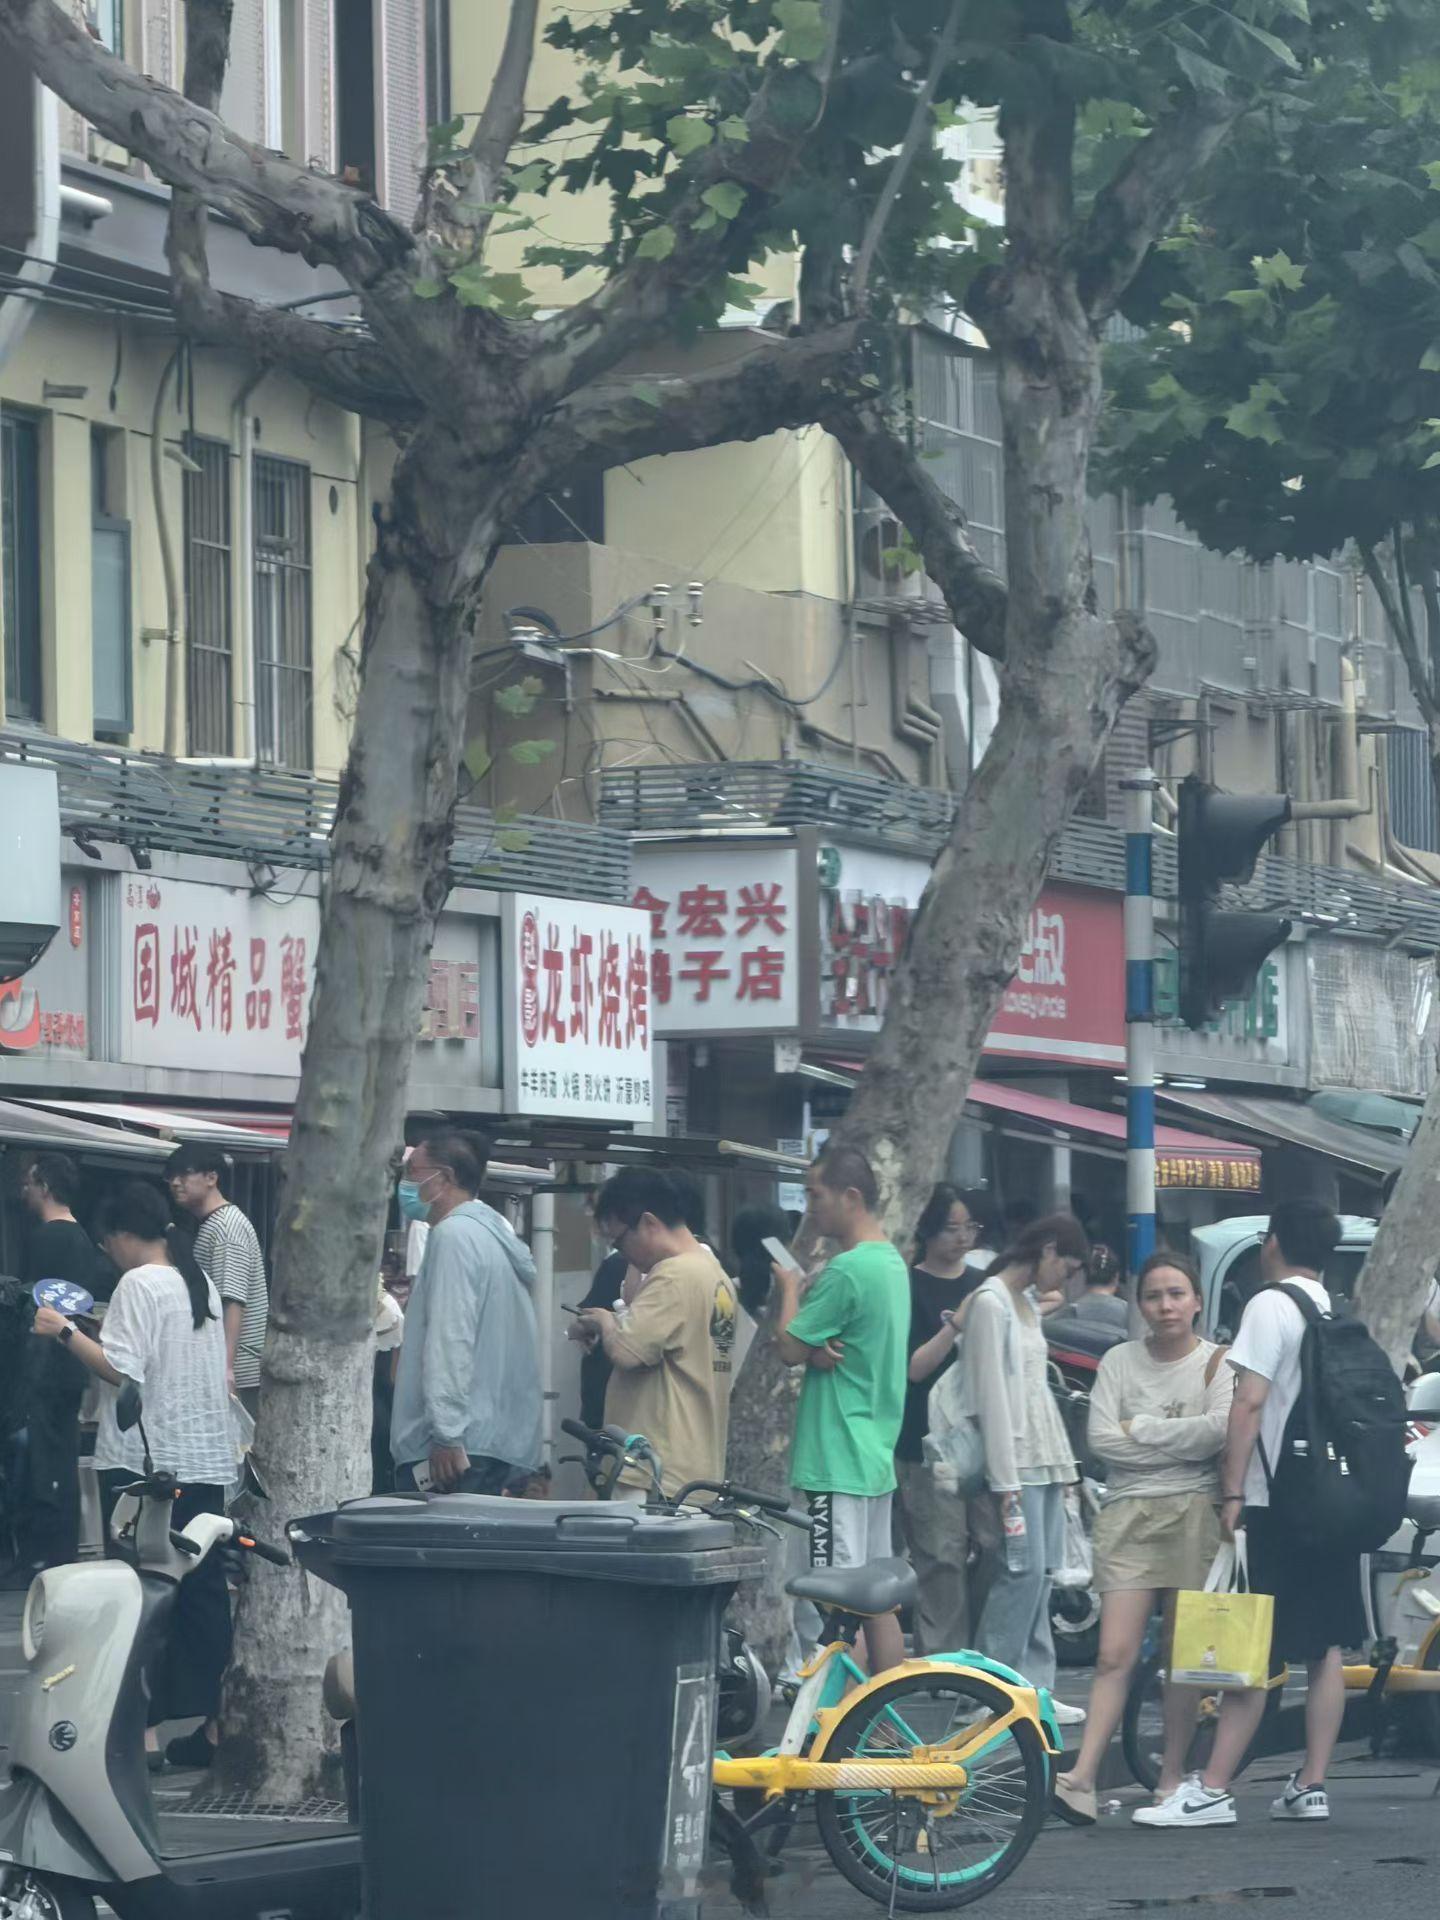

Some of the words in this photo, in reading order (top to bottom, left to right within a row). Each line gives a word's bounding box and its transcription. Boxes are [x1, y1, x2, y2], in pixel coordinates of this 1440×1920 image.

[133, 922, 307, 1041] 固城精品蟹
[541, 921, 648, 1051] 龙虾烧烤
